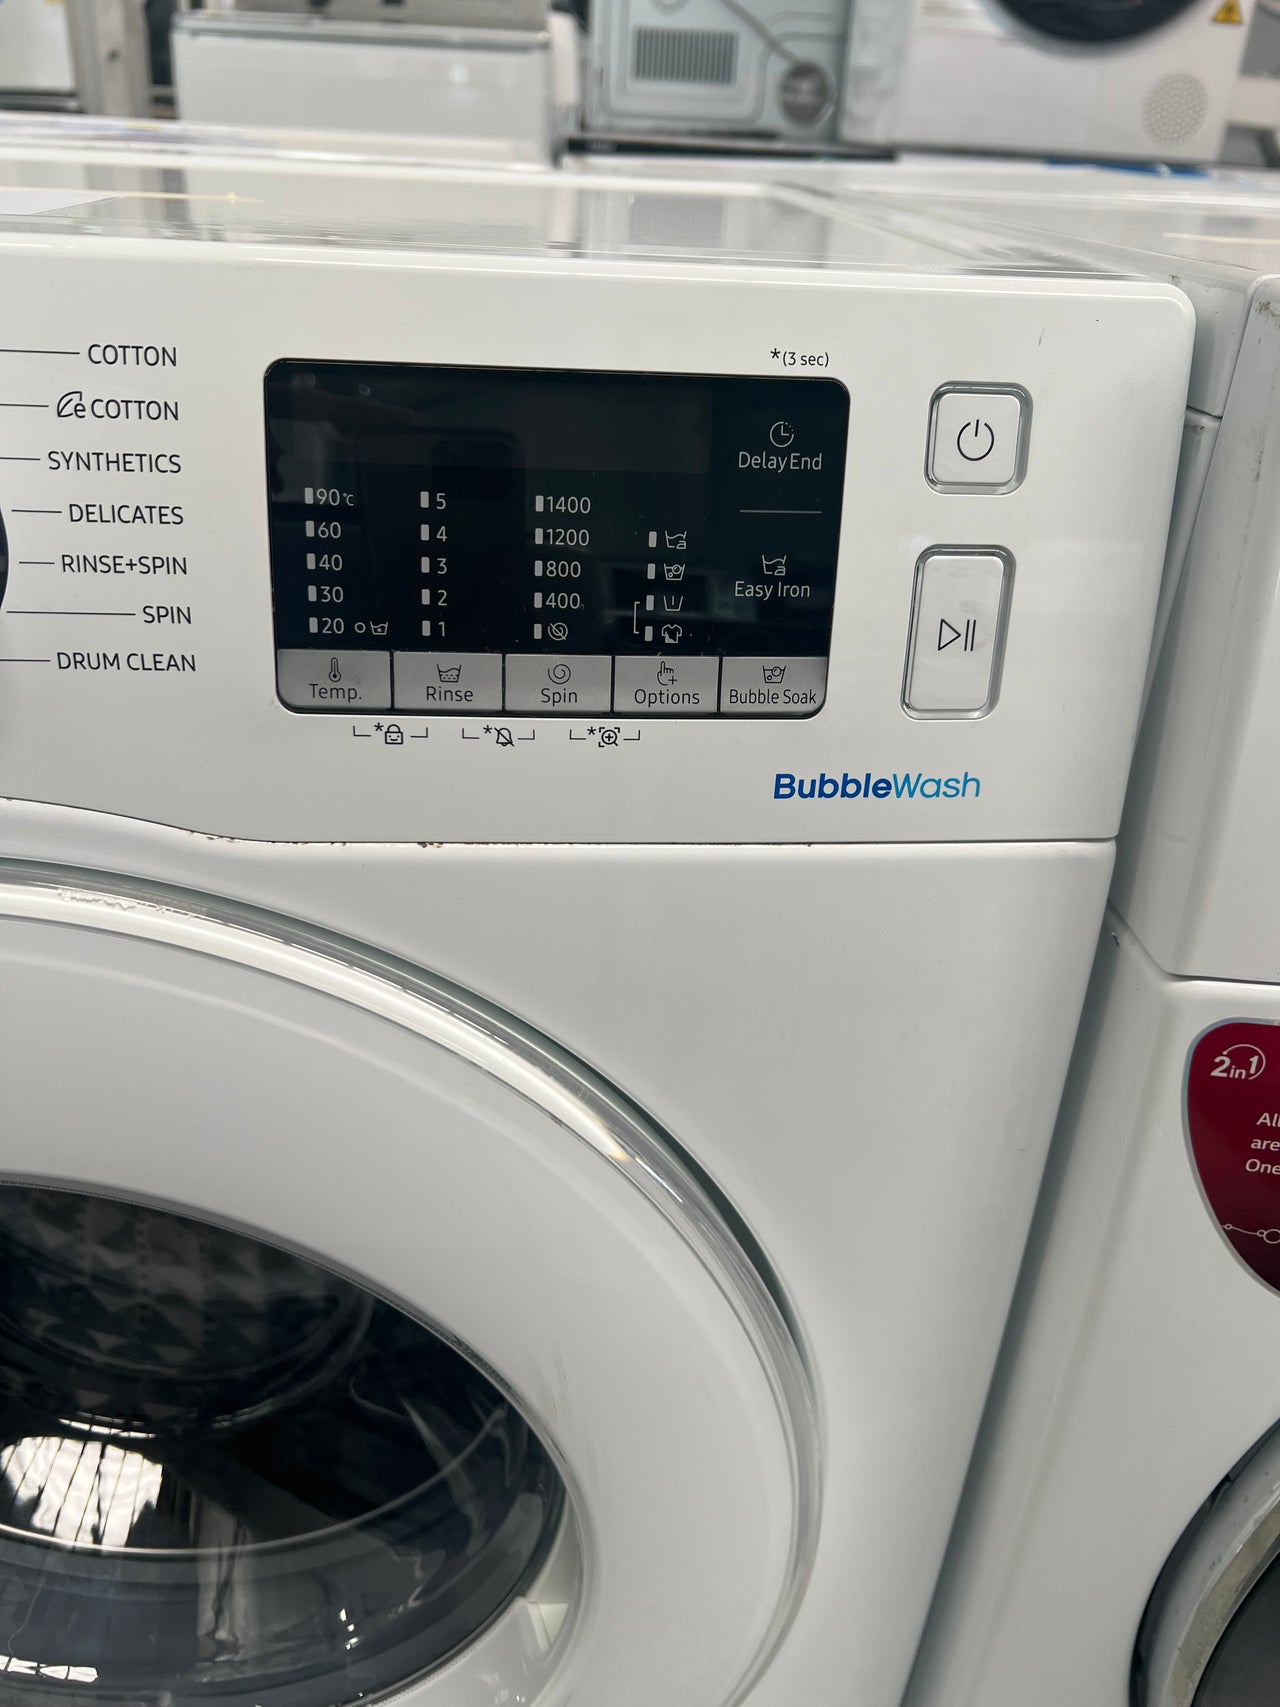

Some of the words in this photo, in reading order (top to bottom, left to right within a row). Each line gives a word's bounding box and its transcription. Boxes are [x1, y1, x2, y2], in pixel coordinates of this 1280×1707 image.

[88, 344, 177, 367] COTTON
[800, 352, 829, 368] sec)
[47, 451, 182, 474] SYNTHETICS
[436, 493, 447, 510] 5
[546, 496, 591, 514] 1400
[68, 504, 184, 525] DELICATES
[317, 522, 342, 539] 60
[436, 526, 448, 542] 4
[546, 529, 590, 547] 1200
[61, 554, 188, 576] RINSE+SPIN
[319, 554, 343, 571] 40
[436, 558, 448, 574] 3
[546, 561, 581, 578] 800
[320, 586, 344, 603] 30
[437, 590, 448, 606] 2
[734, 581, 773, 601] Easy
[777, 582, 810, 598] Iron
[545, 593, 581, 609] 400
[142, 605, 192, 625] SPIN
[321, 618, 345, 634] 20
[438, 621, 446, 637] 1
[56, 652, 121, 671] DRUM
[126, 653, 196, 672] CLEAN
[308, 684, 363, 705] Temp.
[426, 685, 474, 703] Rinse
[540, 688, 578, 706] Spin
[633, 689, 700, 707] Options
[729, 688, 779, 704] Bubble
[782, 688, 817, 704] Soak
[774, 772, 981, 800] BubbleWash
[1250, 1138, 1280, 1152] are
[1245, 1158, 1280, 1175] One
